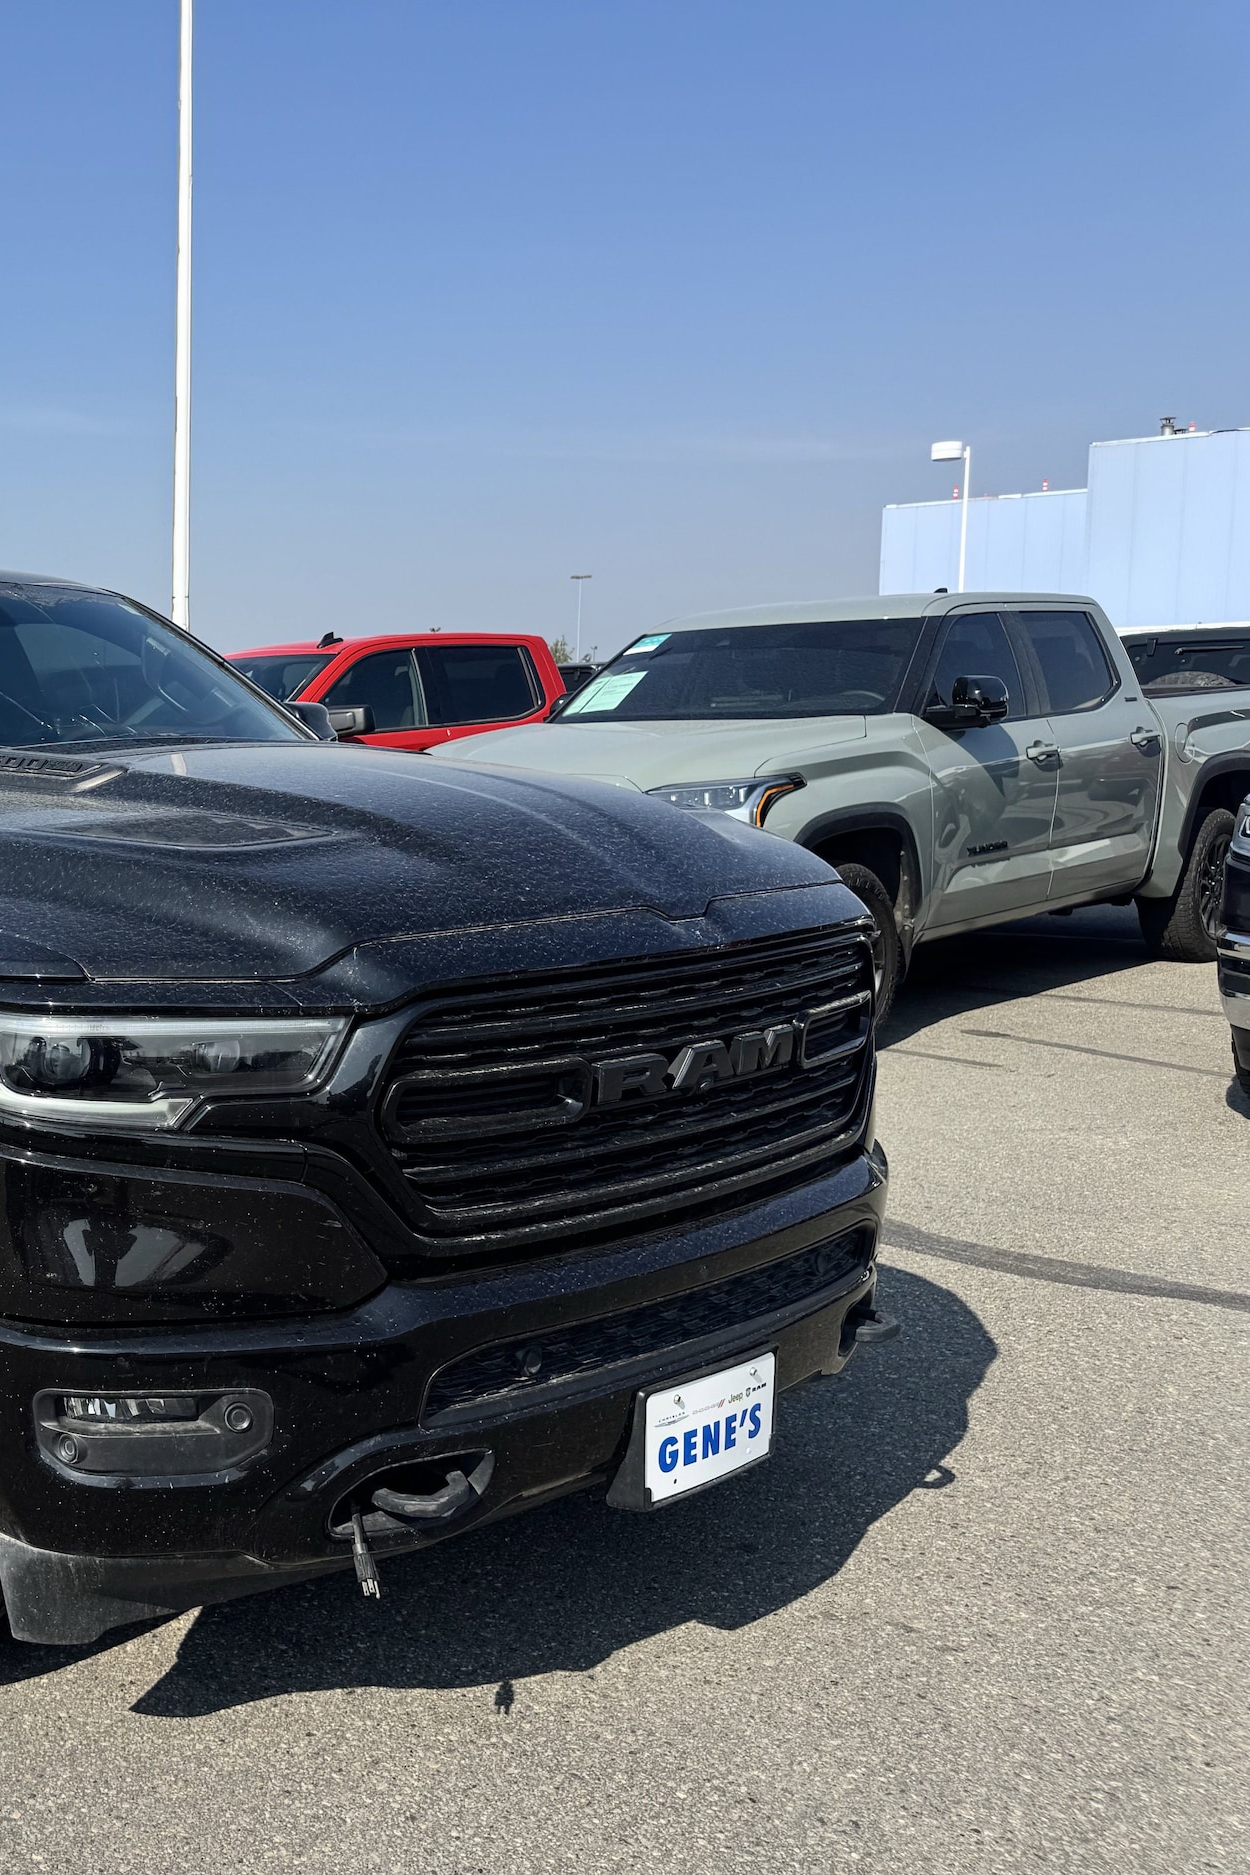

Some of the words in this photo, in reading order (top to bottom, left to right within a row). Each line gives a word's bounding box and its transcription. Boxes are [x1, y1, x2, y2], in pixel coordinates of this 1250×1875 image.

[592, 1024, 794, 1105] RAM
[728, 1392, 744, 1404] Jeep
[752, 1382, 767, 1392] RAM
[658, 1403, 761, 1473] GENE'S
